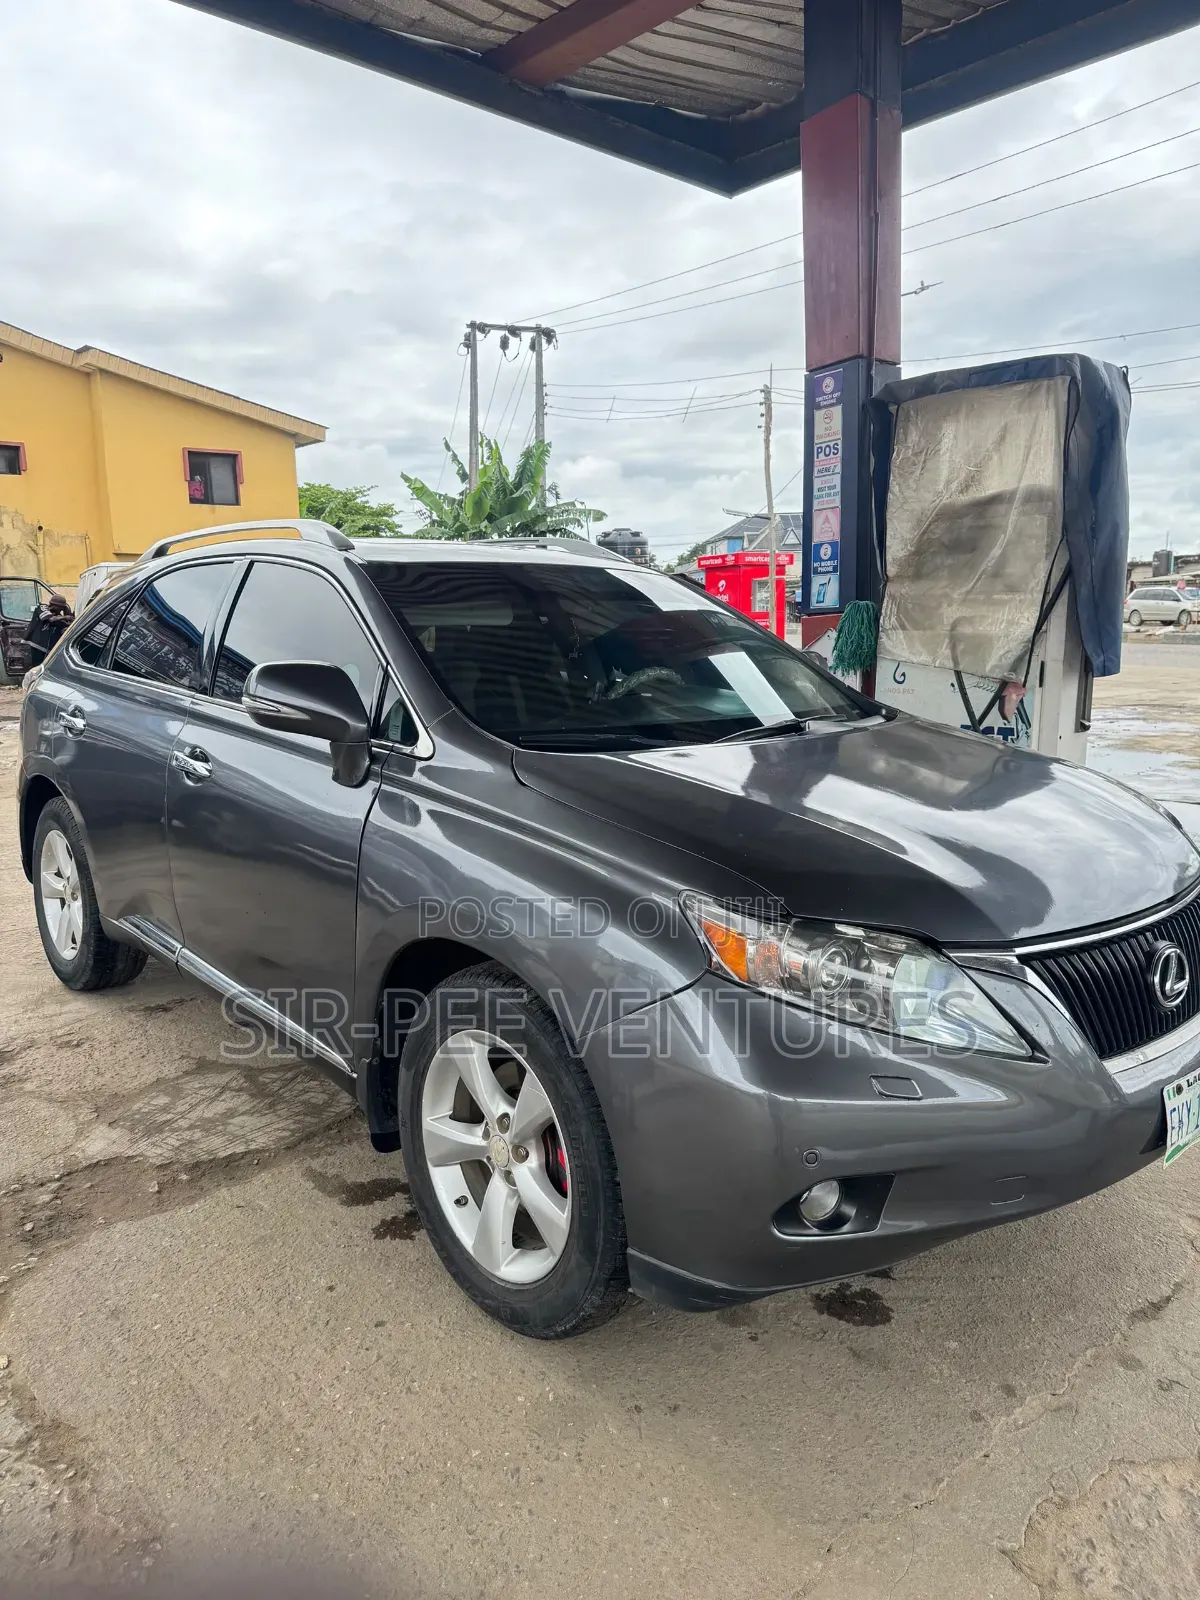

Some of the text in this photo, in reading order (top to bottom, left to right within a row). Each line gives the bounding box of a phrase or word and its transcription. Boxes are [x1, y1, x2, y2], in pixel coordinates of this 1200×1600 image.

[820, 398, 836, 406] ENGINE
[816, 430, 840, 440] SMOKING
[816, 442, 840, 459] POS
[817, 466, 831, 474] HERE
